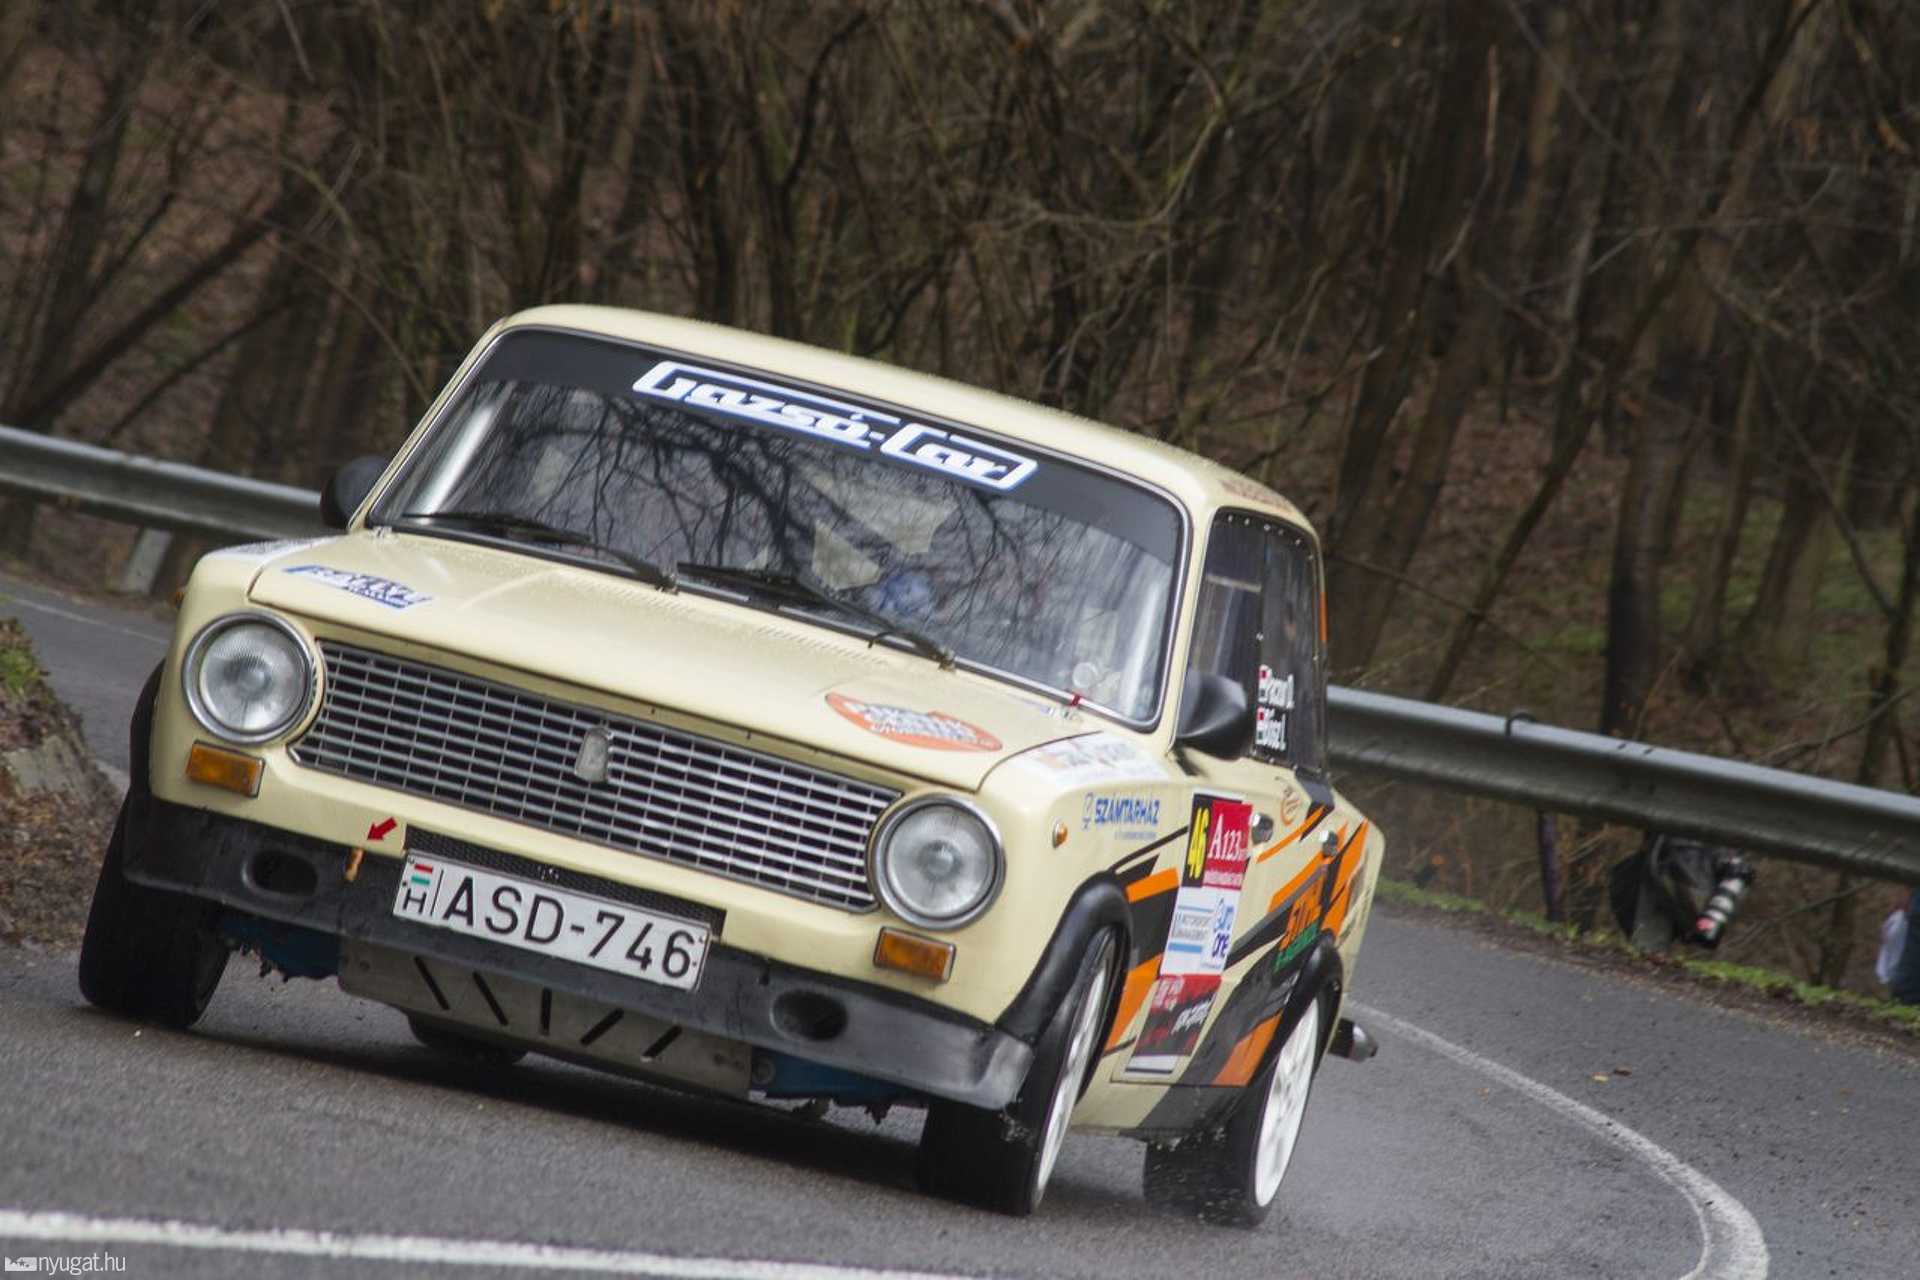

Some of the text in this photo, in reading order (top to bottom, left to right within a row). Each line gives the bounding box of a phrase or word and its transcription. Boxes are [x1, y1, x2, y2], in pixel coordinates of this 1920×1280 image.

[1187, 807, 1210, 879] 46
[402, 888, 428, 915] H
[443, 876, 696, 978] ASD-746
